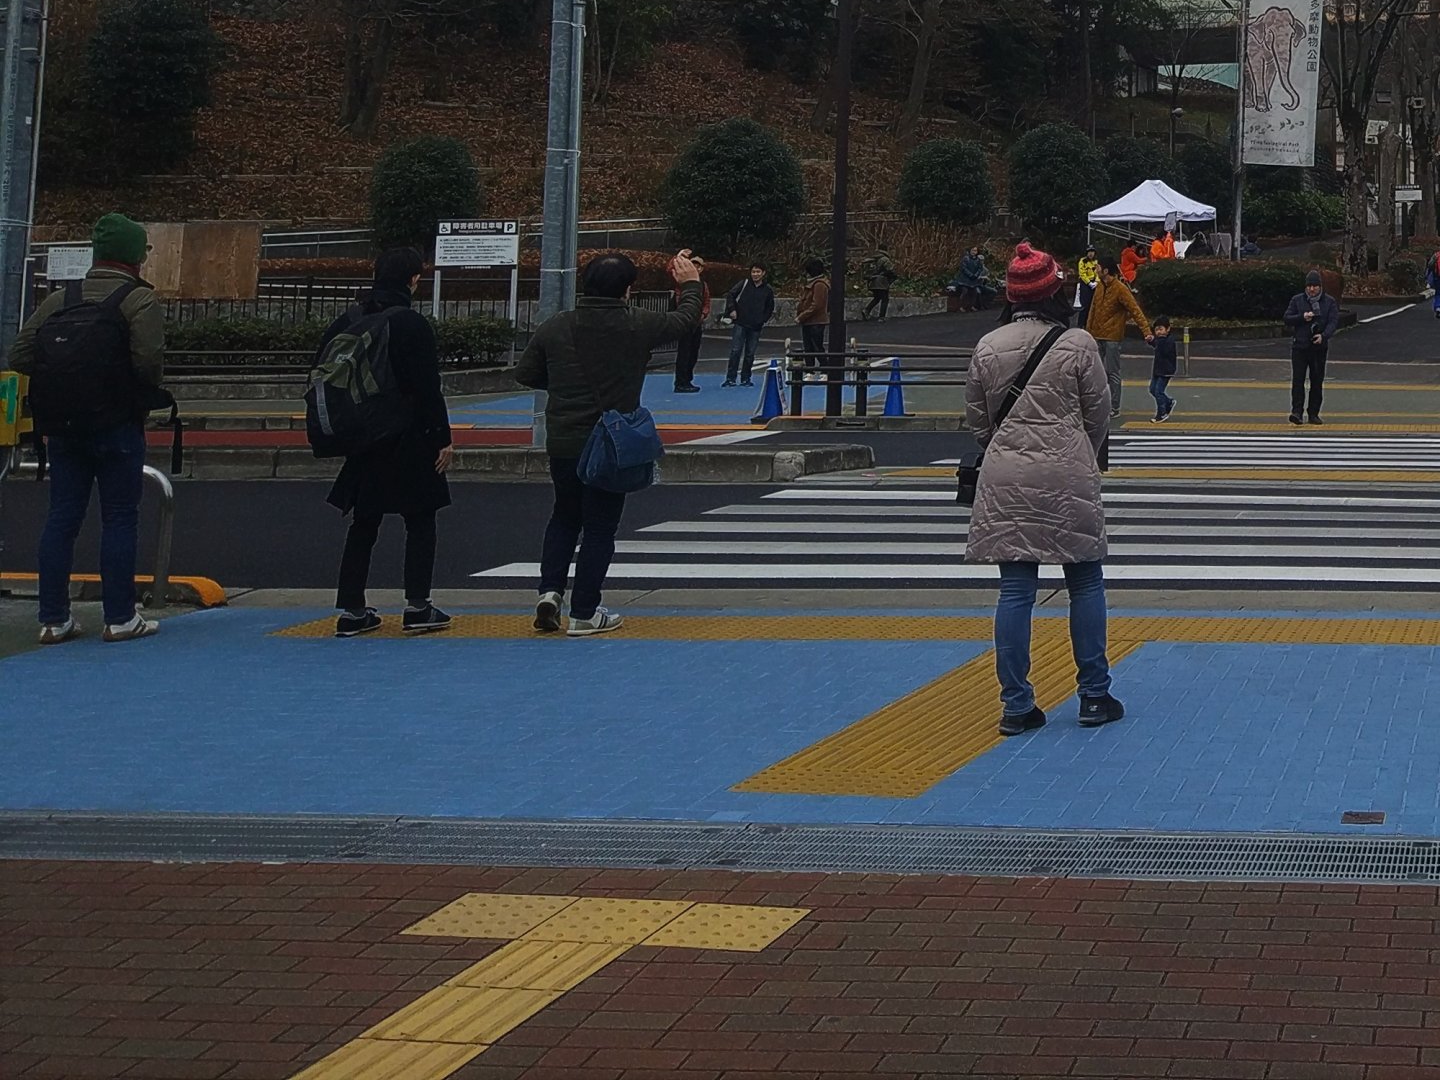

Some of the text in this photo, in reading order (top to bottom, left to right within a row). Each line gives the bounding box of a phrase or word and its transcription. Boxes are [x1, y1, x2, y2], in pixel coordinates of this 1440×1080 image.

[1306, 0, 1320, 72] 多摩動物公園
